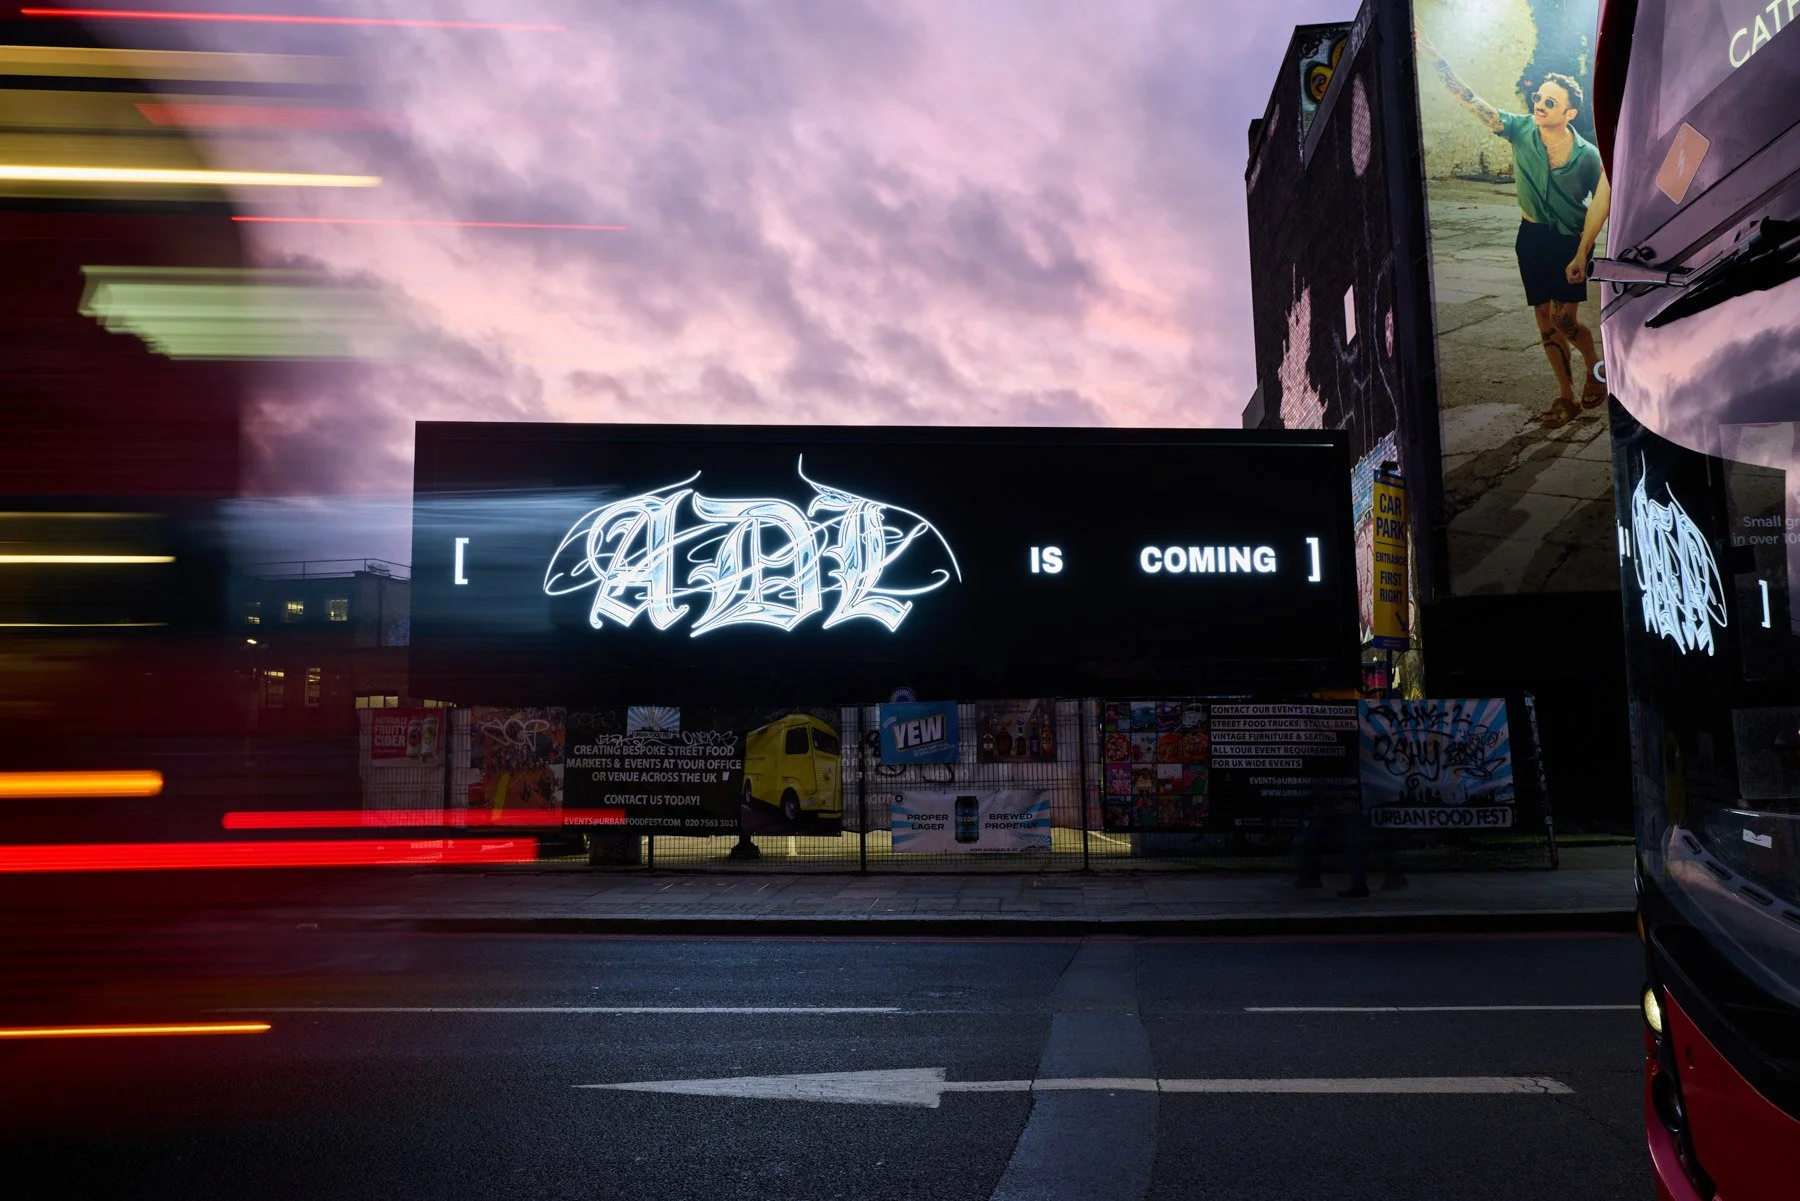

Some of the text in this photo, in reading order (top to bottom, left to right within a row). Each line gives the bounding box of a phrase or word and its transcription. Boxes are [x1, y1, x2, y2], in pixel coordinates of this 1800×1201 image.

[1379, 492, 1402, 517] CAR
[1743, 515, 1781, 528] Small
[1376, 516, 1405, 540] PARK
[1732, 532, 1745, 545] in
[1749, 535, 1781, 545] over
[1030, 546, 1063, 574] IS
[1140, 546, 1276, 573] COMING
[1375, 551, 1407, 567] ENTRANCE
[1380, 570, 1402, 587] FIRST
[1380, 588, 1403, 604] RIGHT
[1211, 706, 1250, 714] CONTACT
[1252, 706, 1270, 714] OUR
[1272, 706, 1303, 714] EVENTS
[1329, 707, 1356, 715] TODAY!
[375, 725, 407, 735] FRUITY
[1211, 720, 1241, 728] STREET
[1243, 720, 1266, 728] FOOD
[892, 714, 945, 751] YEW
[1212, 733, 1336, 741] VINTAGE FURNITURE & SEATING
[375, 735, 406, 747] CIDER
[573, 744, 735, 757] CREATING BESPOKE STREET FOOD
[1283, 746, 1345, 755] REQUIREMENTS
[566, 758, 742, 770] MARKETS & EVENTS AT YOUR OFFICE
[1213, 759, 1301, 767] FOR UK WIDE EVENTS
[592, 772, 717, 783] OR VENUE ACROSS THE UK
[604, 794, 701, 806] CONTACT US TODAY!
[564, 817, 738, 828] EVENTS@URBANFOODFEST.COM 020 7563 3021
[907, 814, 949, 822] PROPER
[989, 813, 1033, 821] BREWED
[1373, 809, 1425, 826] URBAN
[1429, 809, 1474, 826] FOOD
[1476, 808, 1508, 825] FEST
[984, 822, 1037, 830] PROPERLY
